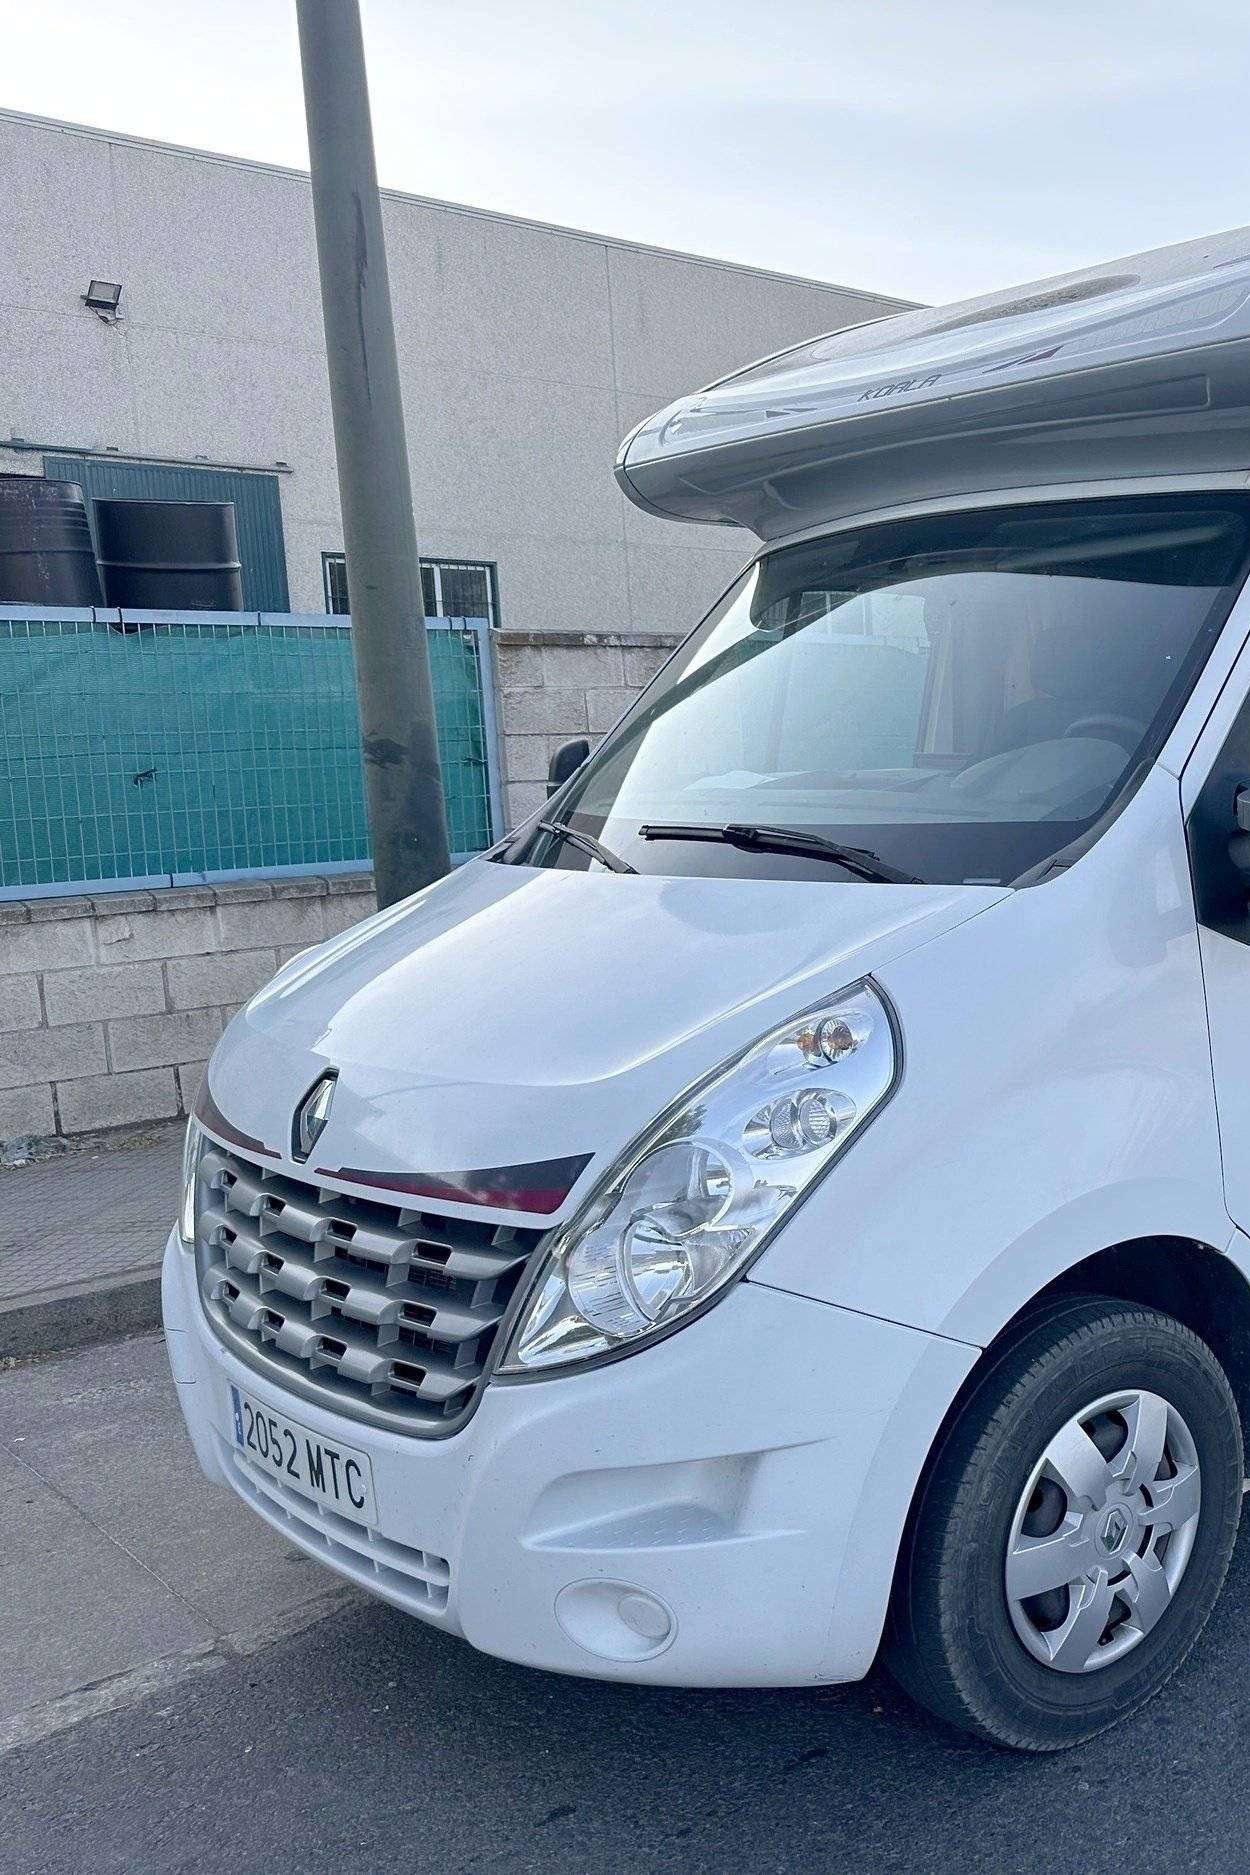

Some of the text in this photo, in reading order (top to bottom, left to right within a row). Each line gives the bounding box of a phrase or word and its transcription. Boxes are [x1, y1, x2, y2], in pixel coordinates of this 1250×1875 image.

[856, 374, 942, 402] KOALA
[244, 1401, 365, 1509] 2052 MTC
